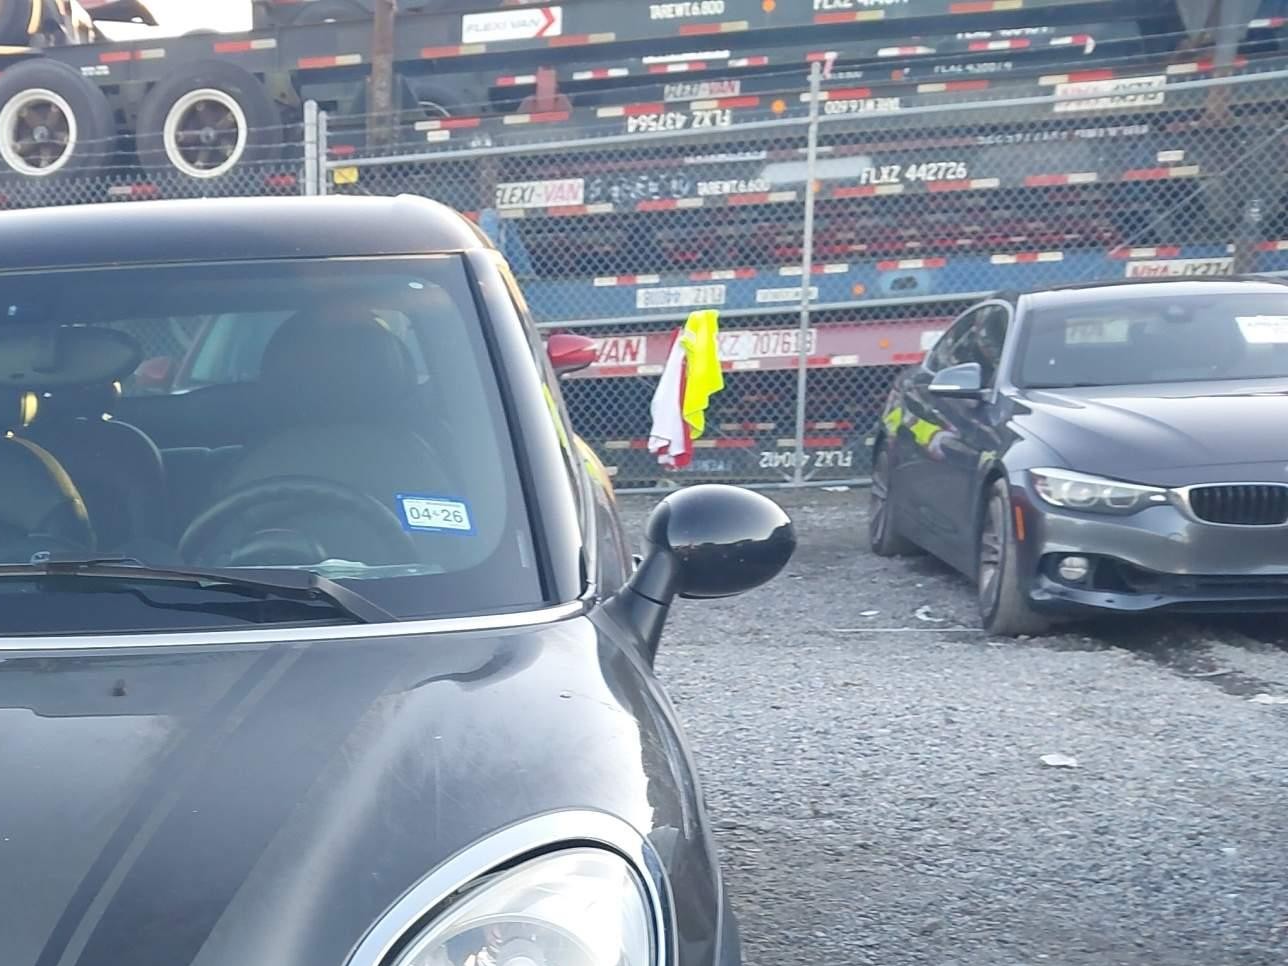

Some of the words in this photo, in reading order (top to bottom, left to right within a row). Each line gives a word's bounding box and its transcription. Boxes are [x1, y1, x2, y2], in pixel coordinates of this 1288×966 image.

[465, 21, 507, 33] FLEXI
[510, 17, 541, 30] VAN
[627, 111, 687, 132] 437564
[692, 110, 732, 129] FLXZ
[860, 164, 900, 184] FLXZ
[904, 161, 967, 182] 442726
[813, 451, 854, 468] FLXZ
